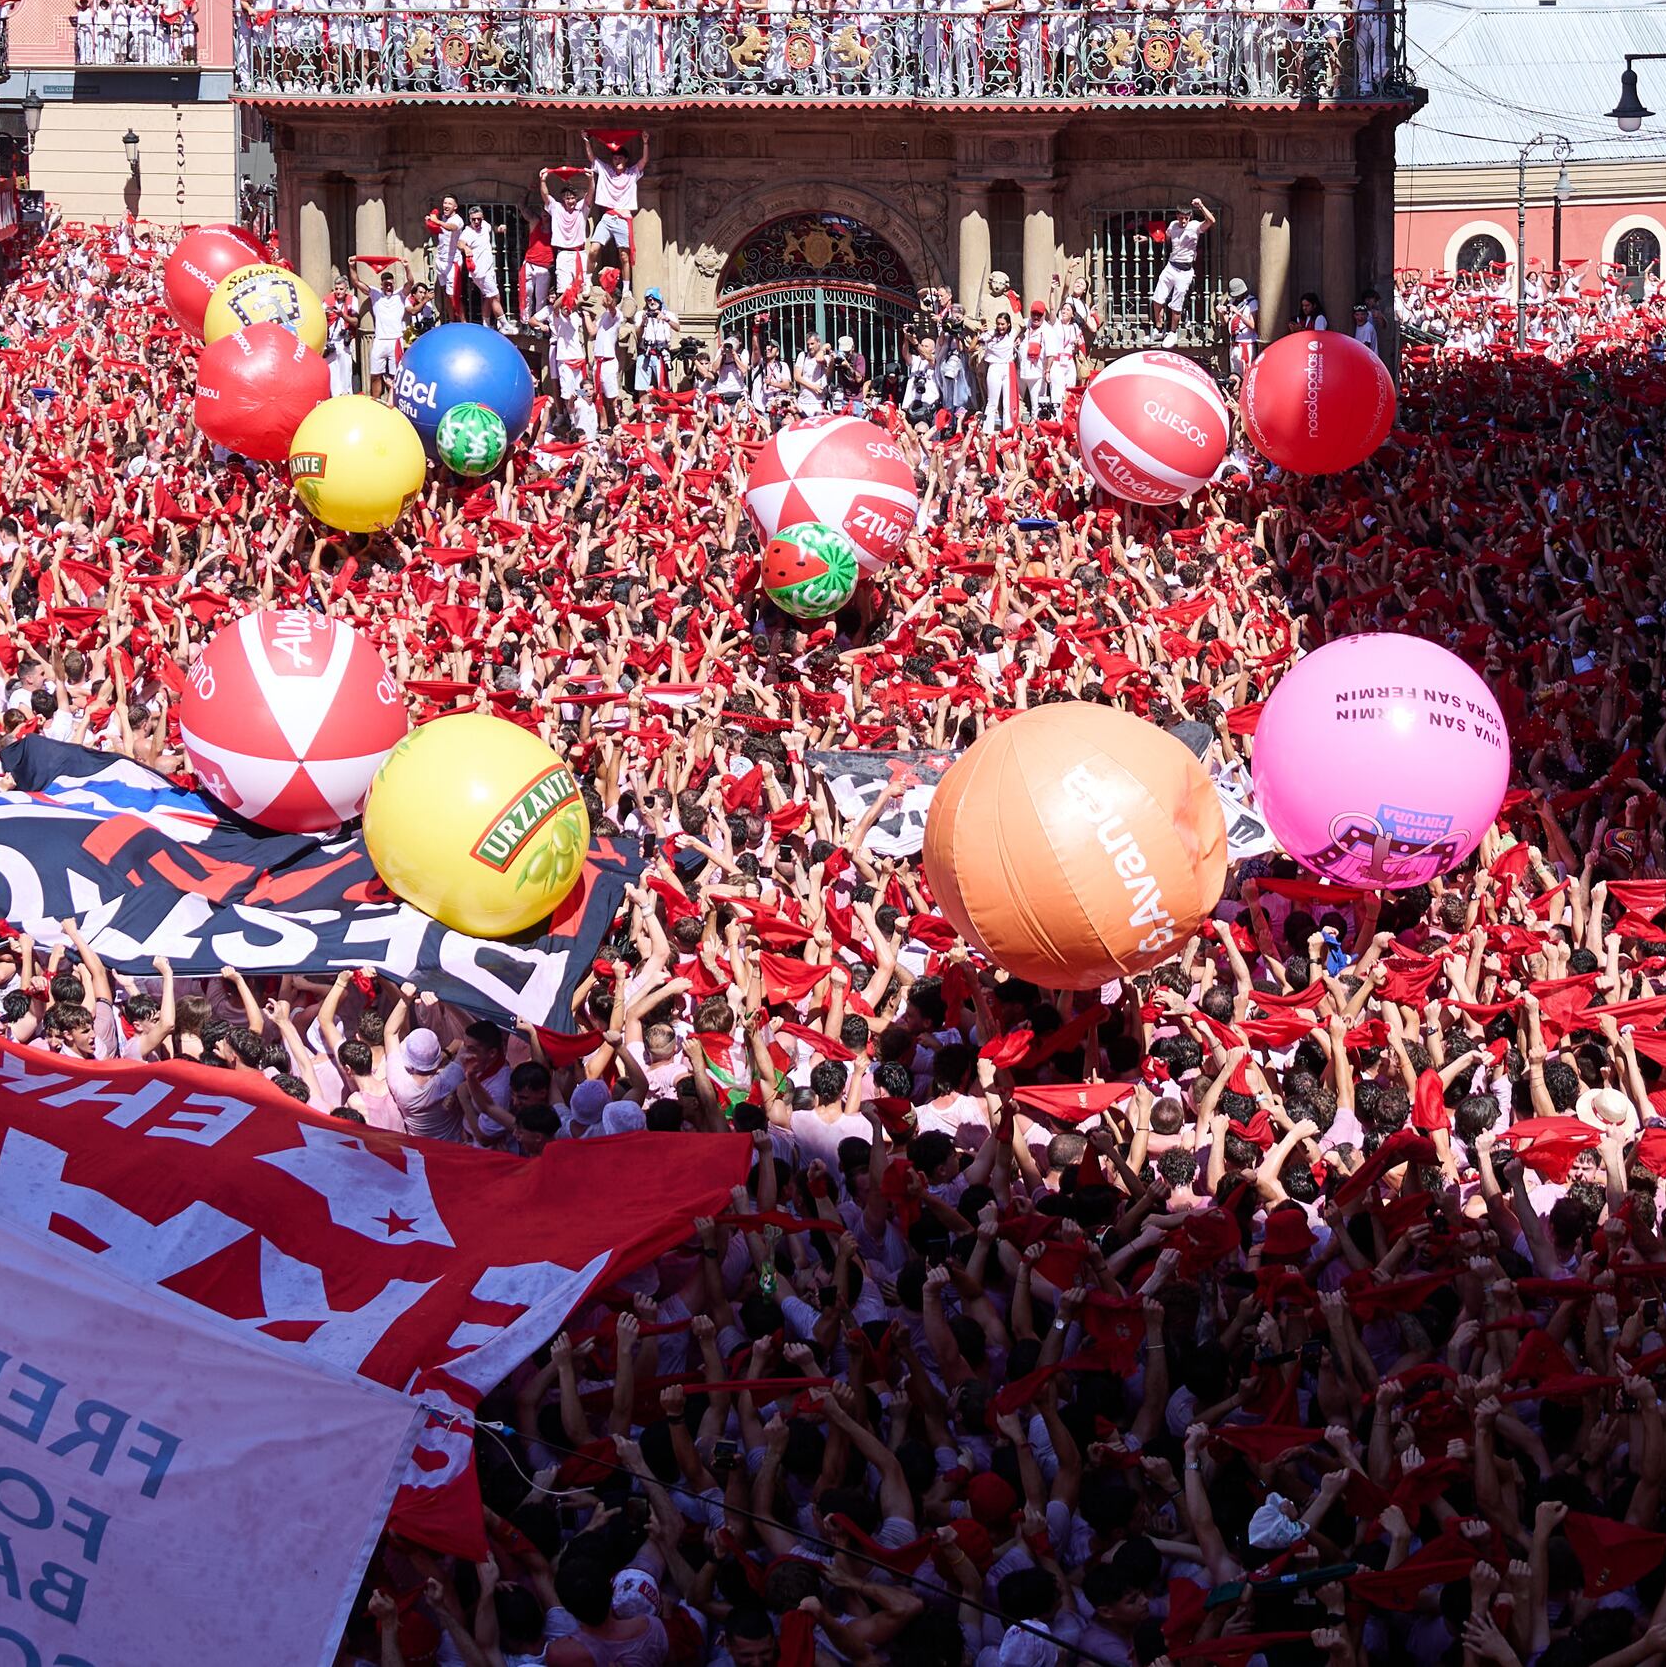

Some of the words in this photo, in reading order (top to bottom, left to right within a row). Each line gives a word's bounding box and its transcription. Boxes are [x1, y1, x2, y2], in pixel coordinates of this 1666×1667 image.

[226, 267, 283, 292] Satori
[398, 398, 419, 419] Sifu
[1303, 353, 1320, 438] nosolopatas
[1142, 400, 1208, 449] QUESOS
[1096, 447, 1181, 502] Albéniz
[1424, 688, 1461, 708] SAN
[1429, 712, 1466, 732] SAN
[1466, 700, 1501, 731] GORA
[1474, 724, 1502, 750] VIVA
[482, 770, 576, 860] URZANTE
[1383, 808, 1448, 828] PINTURA
